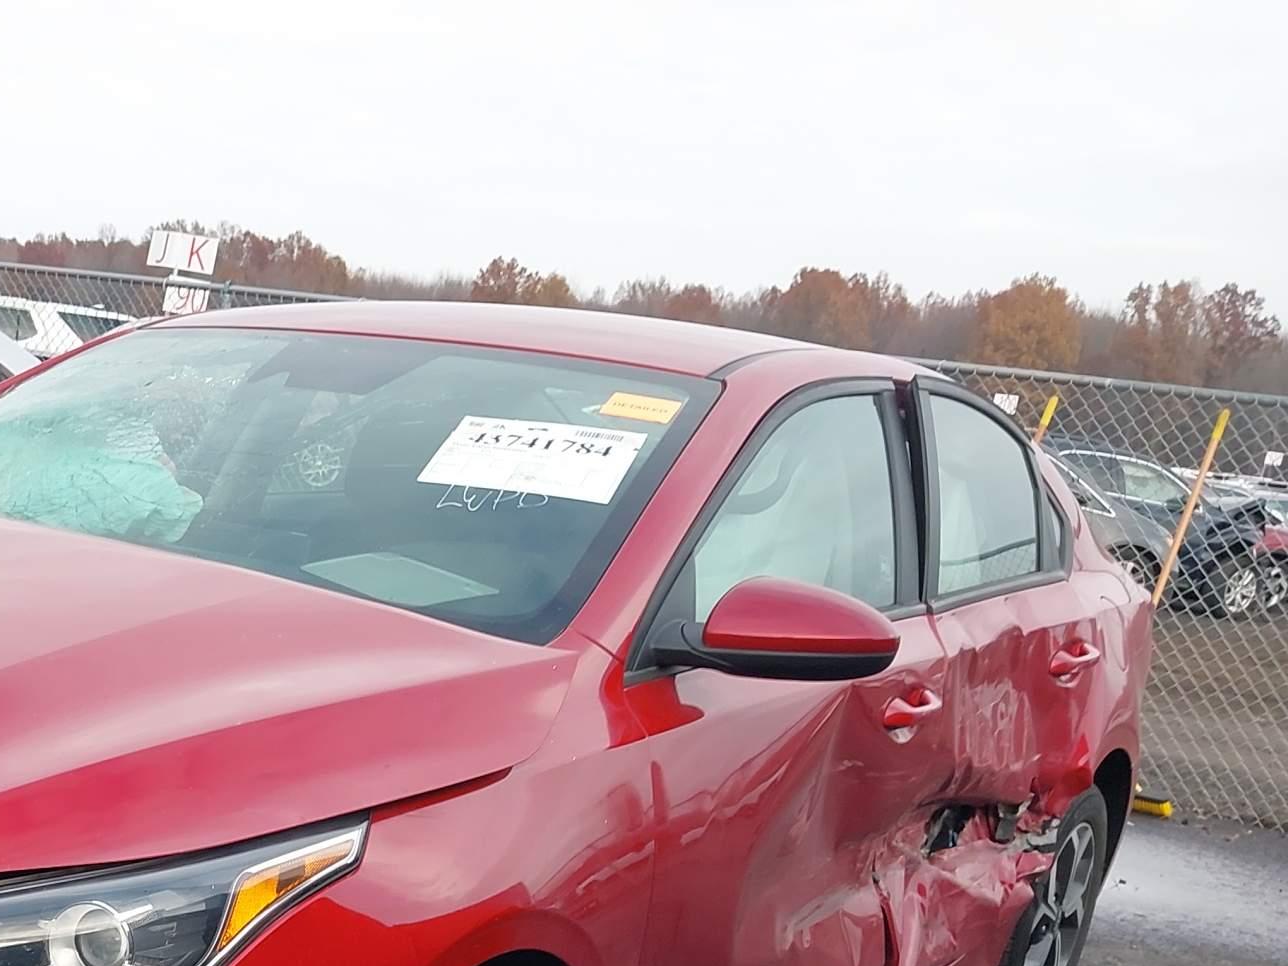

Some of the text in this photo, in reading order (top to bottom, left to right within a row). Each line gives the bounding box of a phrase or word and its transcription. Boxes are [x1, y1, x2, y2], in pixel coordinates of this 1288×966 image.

[154, 232, 210, 271] J K
[468, 432, 613, 457] 43741784
